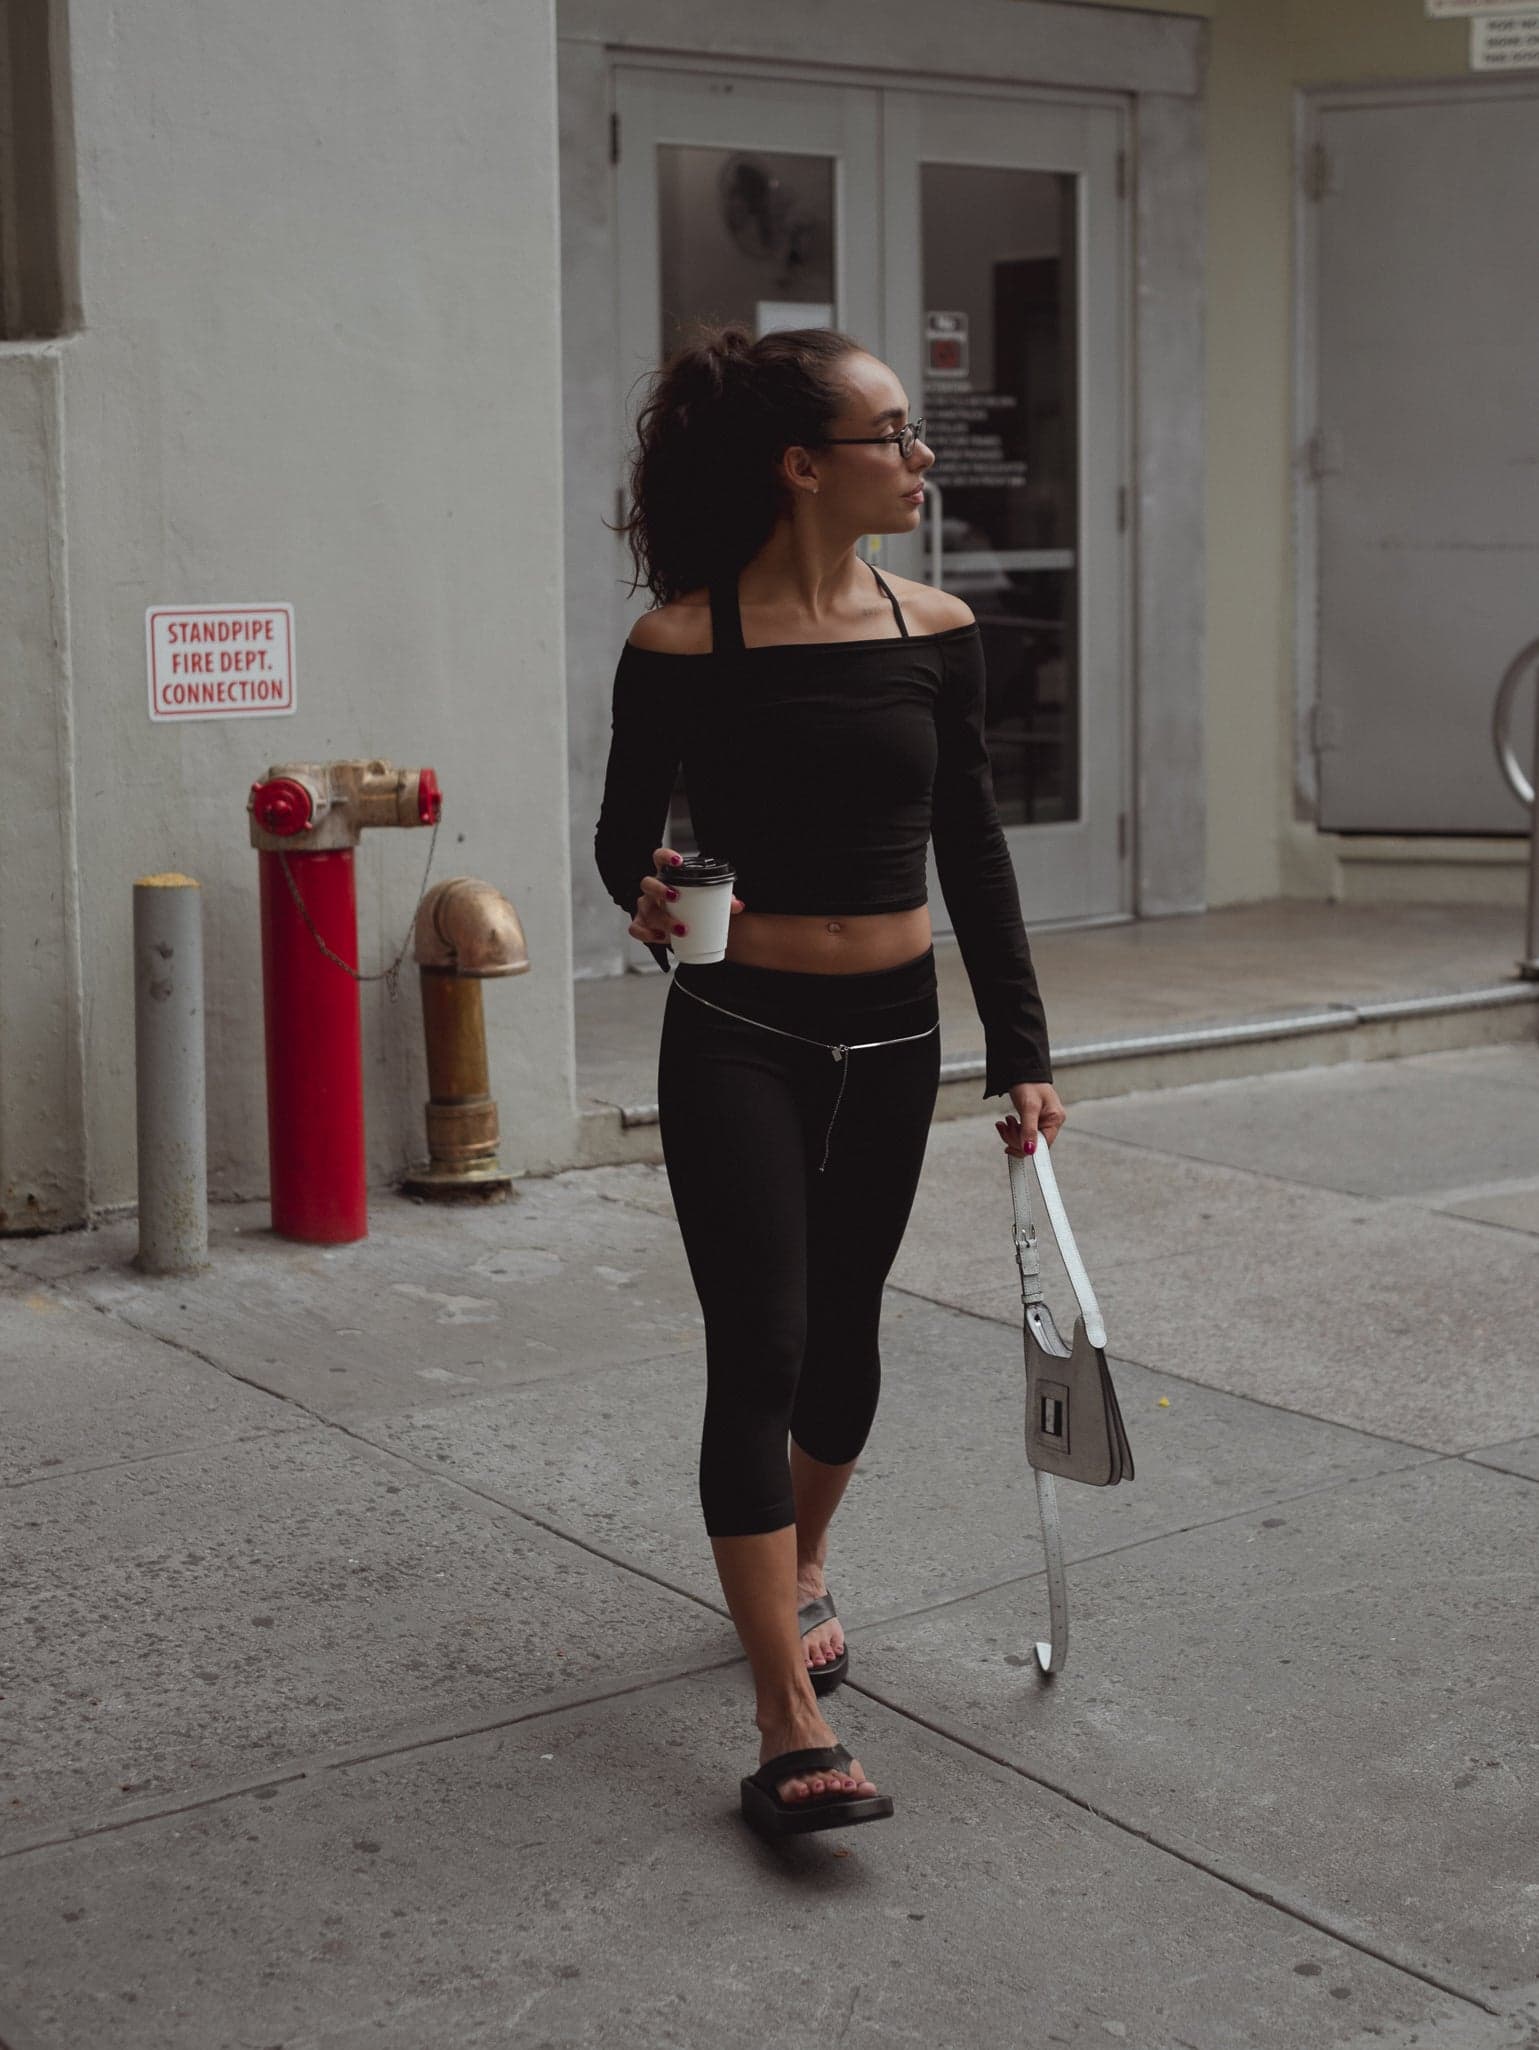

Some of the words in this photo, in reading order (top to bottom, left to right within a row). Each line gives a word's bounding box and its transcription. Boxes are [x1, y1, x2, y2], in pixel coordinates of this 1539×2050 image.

[168, 619, 273, 644] STANDPIPE
[172, 651, 215, 674] FIRE
[220, 650, 273, 672] DEPT.
[162, 679, 283, 704] CONNECTION
